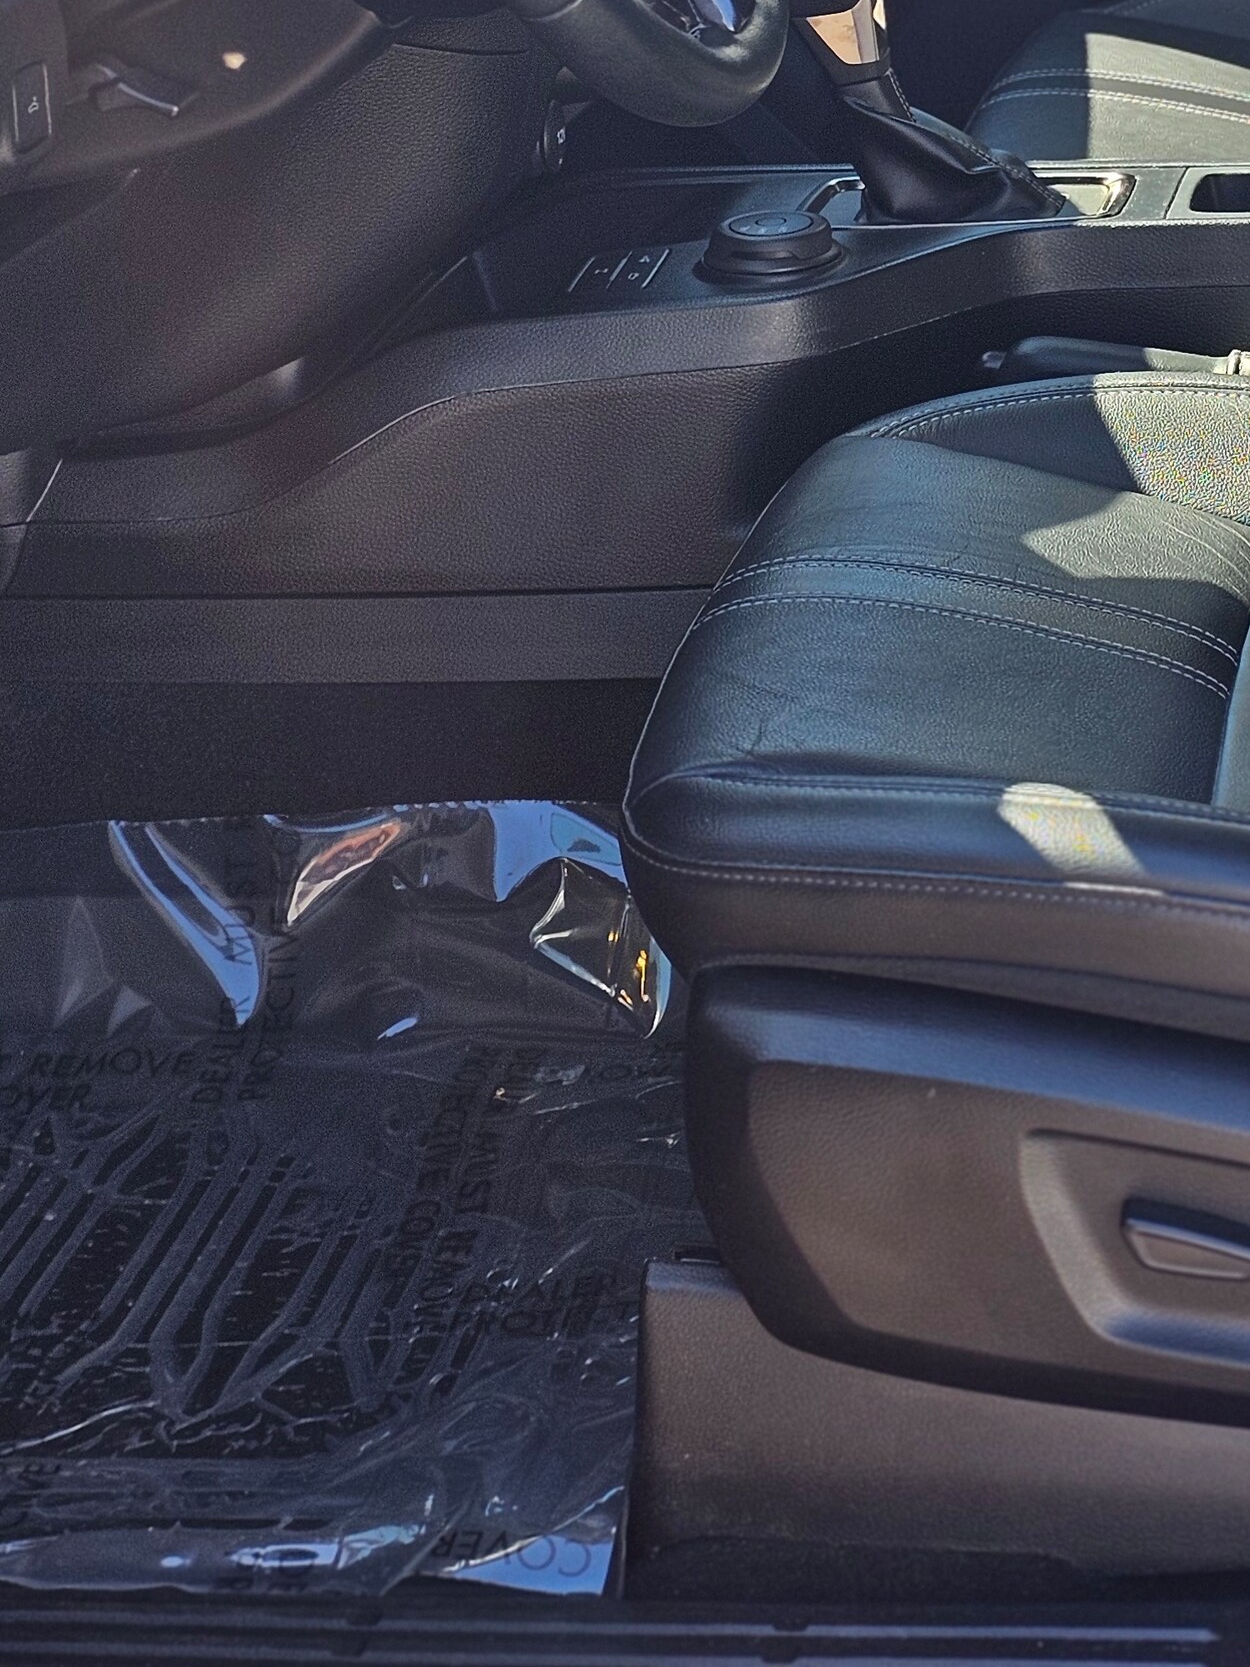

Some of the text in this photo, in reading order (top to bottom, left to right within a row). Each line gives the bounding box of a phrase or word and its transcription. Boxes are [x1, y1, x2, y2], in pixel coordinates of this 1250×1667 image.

[223, 857, 256, 967] MUST
[28, 1045, 197, 1079] REMOVE
[433, 1530, 593, 1578] COVER
